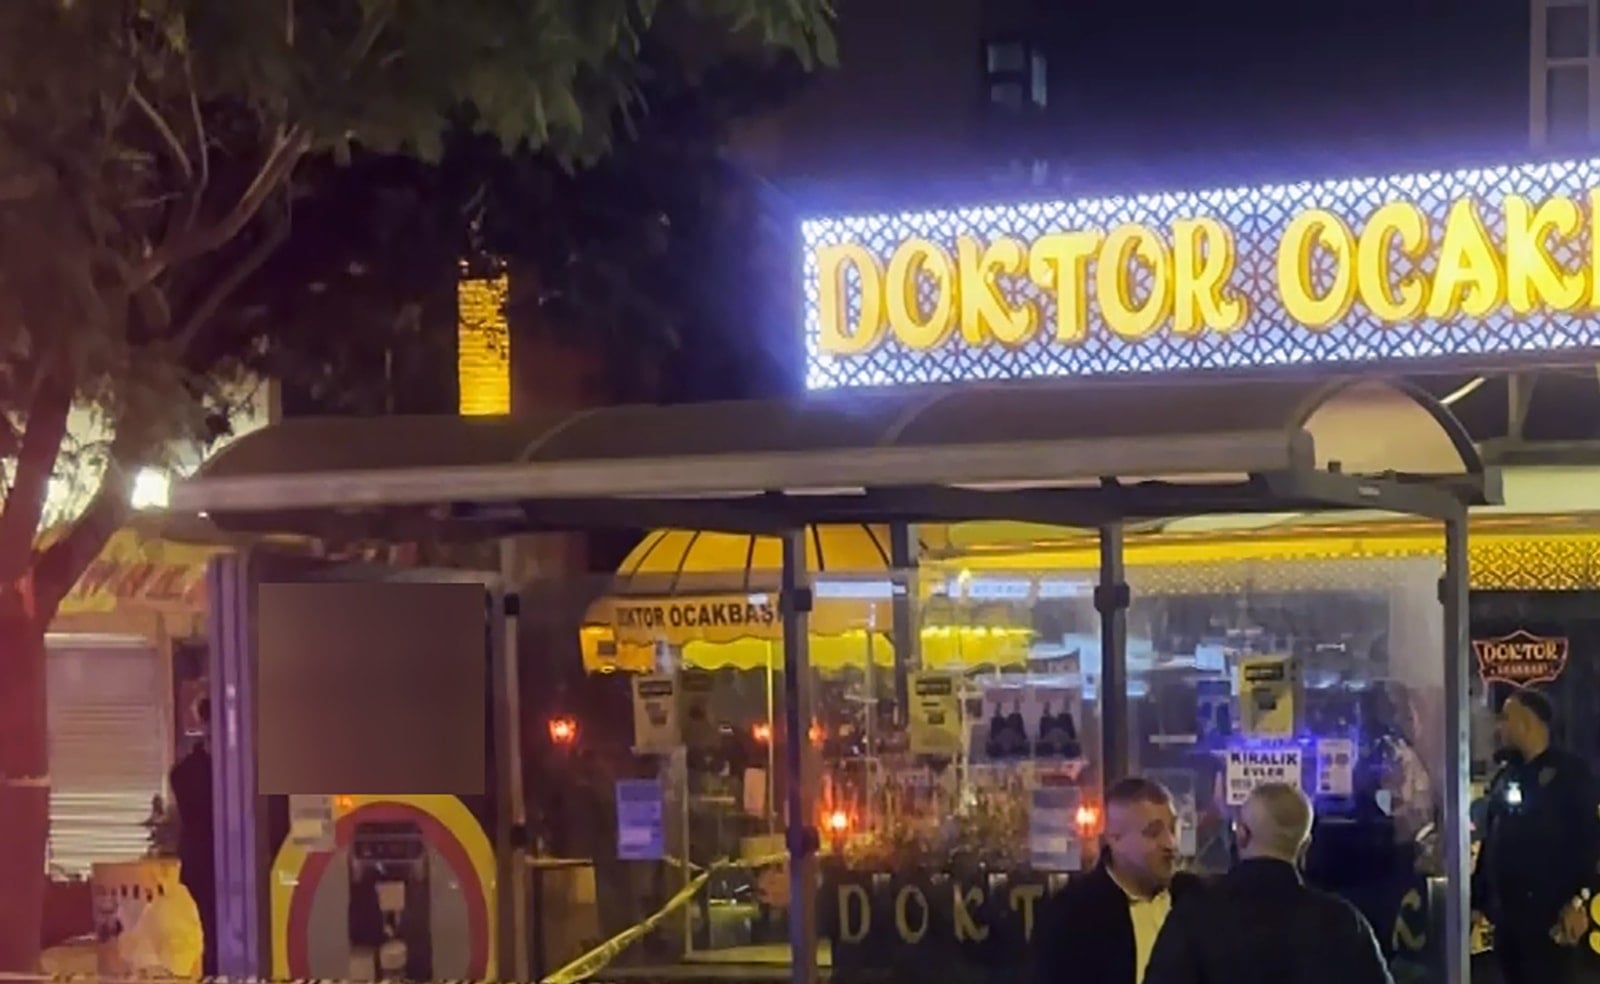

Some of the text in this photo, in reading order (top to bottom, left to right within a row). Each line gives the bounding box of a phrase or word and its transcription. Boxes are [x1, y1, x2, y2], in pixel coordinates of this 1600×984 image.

[816, 217, 1248, 355] DOKTOR
[1483, 640, 1559, 661] DOKTOR
[837, 883, 1045, 944] DOKT
